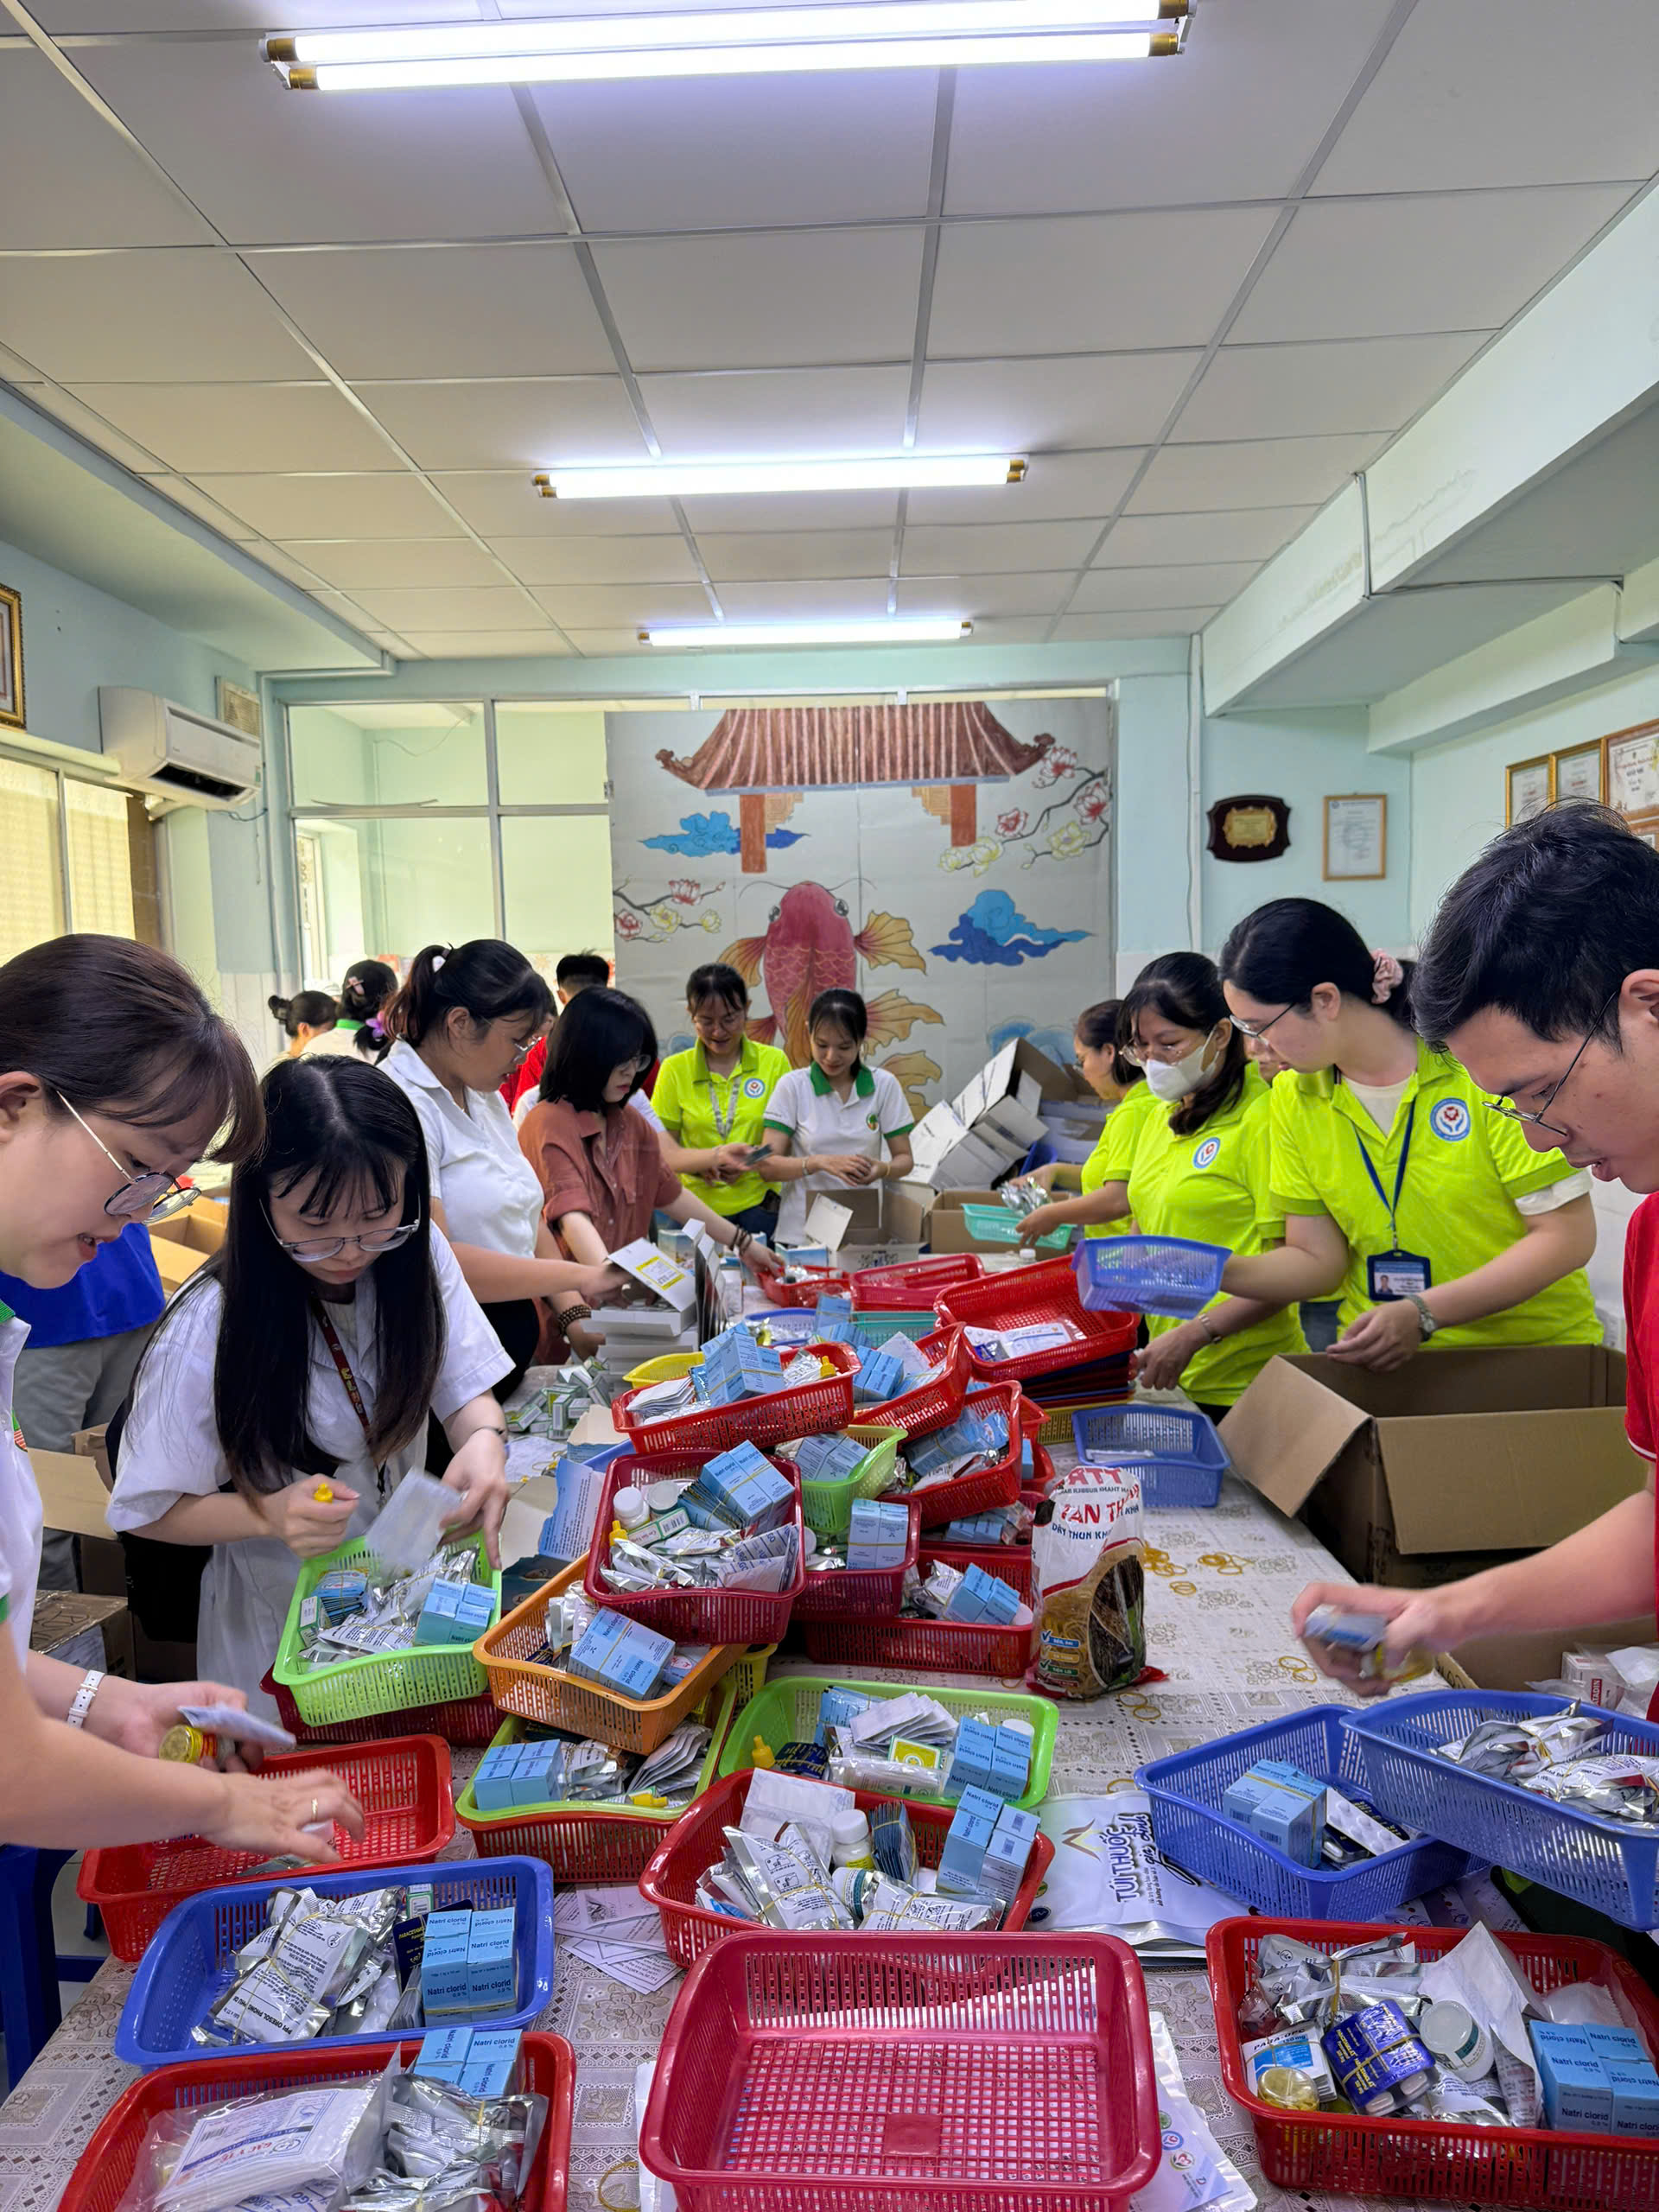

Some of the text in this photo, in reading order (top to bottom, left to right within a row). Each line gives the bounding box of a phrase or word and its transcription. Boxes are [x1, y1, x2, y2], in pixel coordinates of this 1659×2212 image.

[966, 1790, 999, 1809] Natri clorid
[1100, 1827, 1138, 1902] TÚI THUỐC
[427, 1949, 448, 1958] clorid
[427, 1983, 467, 1996] Natri clorid
[472, 1979, 512, 1993] Natri clorid
[263, 2013, 283, 2030] ORESOL
[494, 2037, 516, 2046] clorid
[1541, 2034, 1565, 2043] clorid
[1589, 2032, 1637, 2044] Natri clorid
[1551, 2056, 1599, 2069] Natri clorid
[1561, 2107, 1609, 2120] Natri clorid
[1617, 2120, 1638, 2130] Natri
